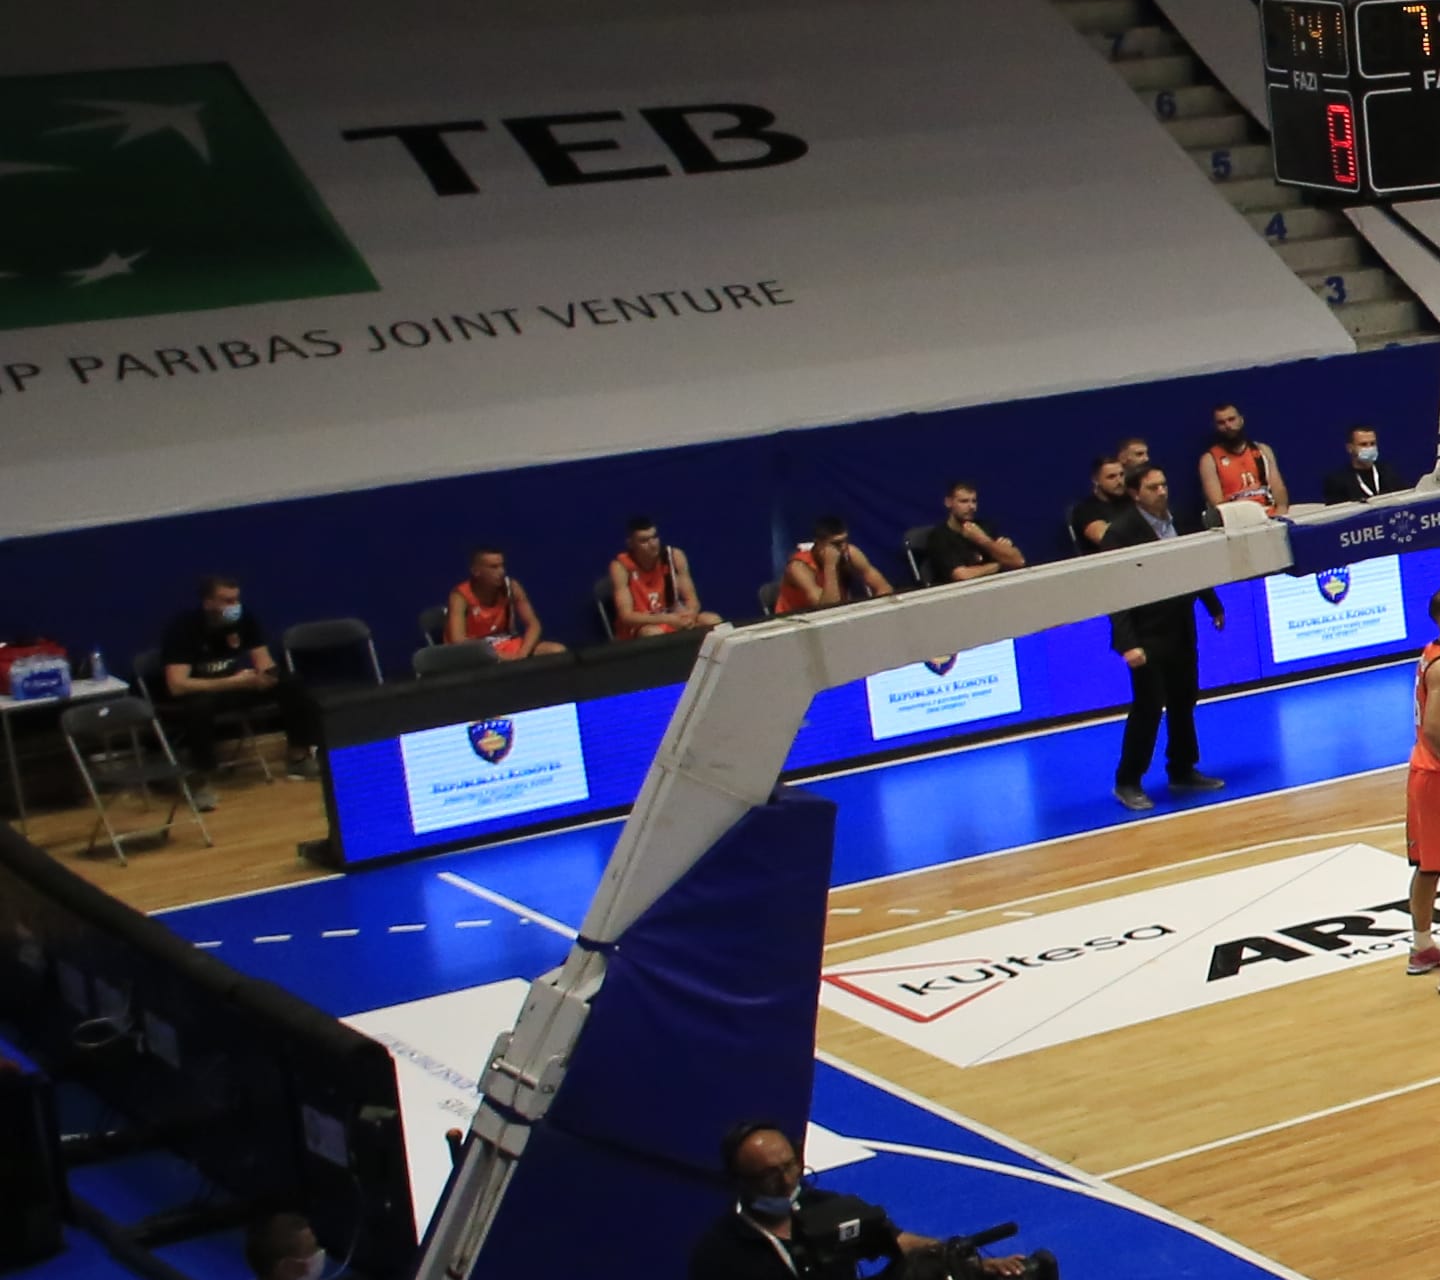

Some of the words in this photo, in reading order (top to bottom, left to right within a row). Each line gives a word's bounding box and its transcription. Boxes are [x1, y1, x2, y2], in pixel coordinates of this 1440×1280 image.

[342, 103, 809, 196] TEB
[1265, 212, 1288, 241] 4
[1325, 276, 1347, 306] 3
[68, 328, 343, 387] PARIBAS
[367, 308, 527, 353] JOINT
[538, 279, 796, 330] VENTURE
[1340, 525, 1385, 548] SURE
[899, 922, 1175, 997] kujtesa
